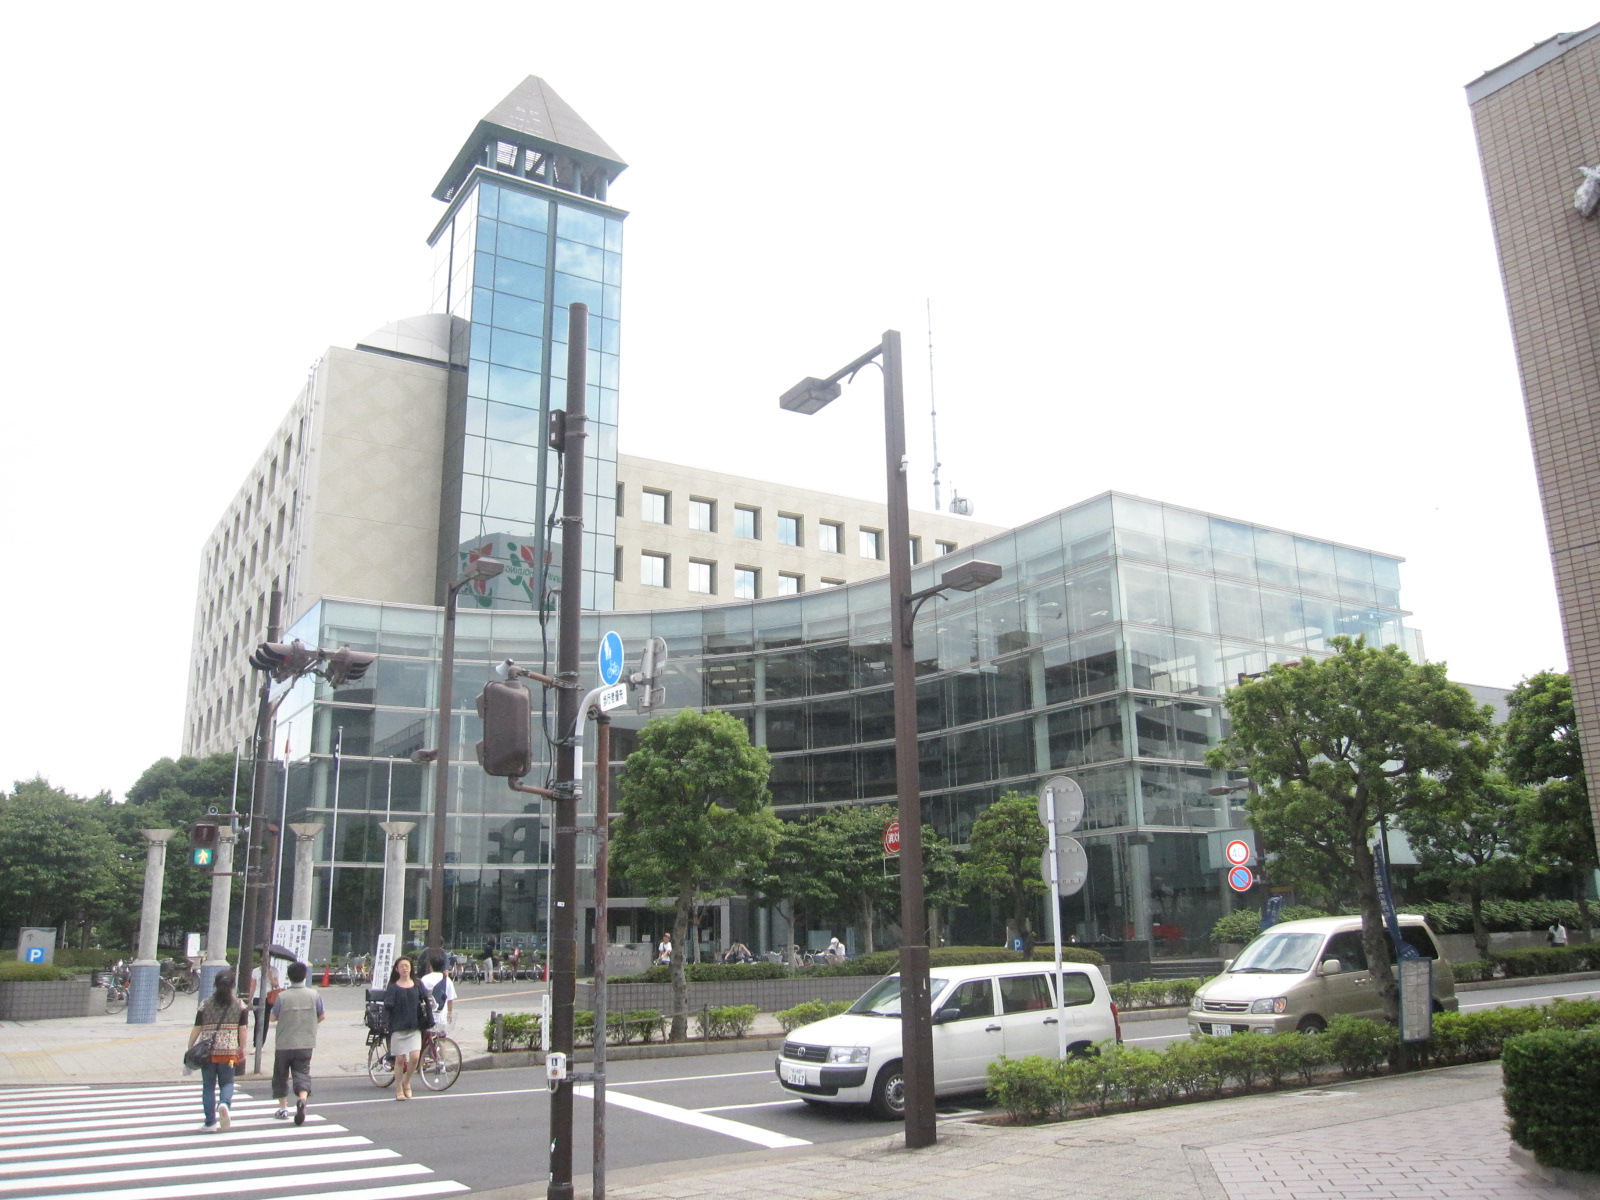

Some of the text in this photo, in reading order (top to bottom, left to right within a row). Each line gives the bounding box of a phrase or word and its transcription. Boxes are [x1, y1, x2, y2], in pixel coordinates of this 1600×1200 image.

[1232, 847, 1243, 858] 40
[1014, 939, 1021, 951] P
[30, 949, 42, 962] P
